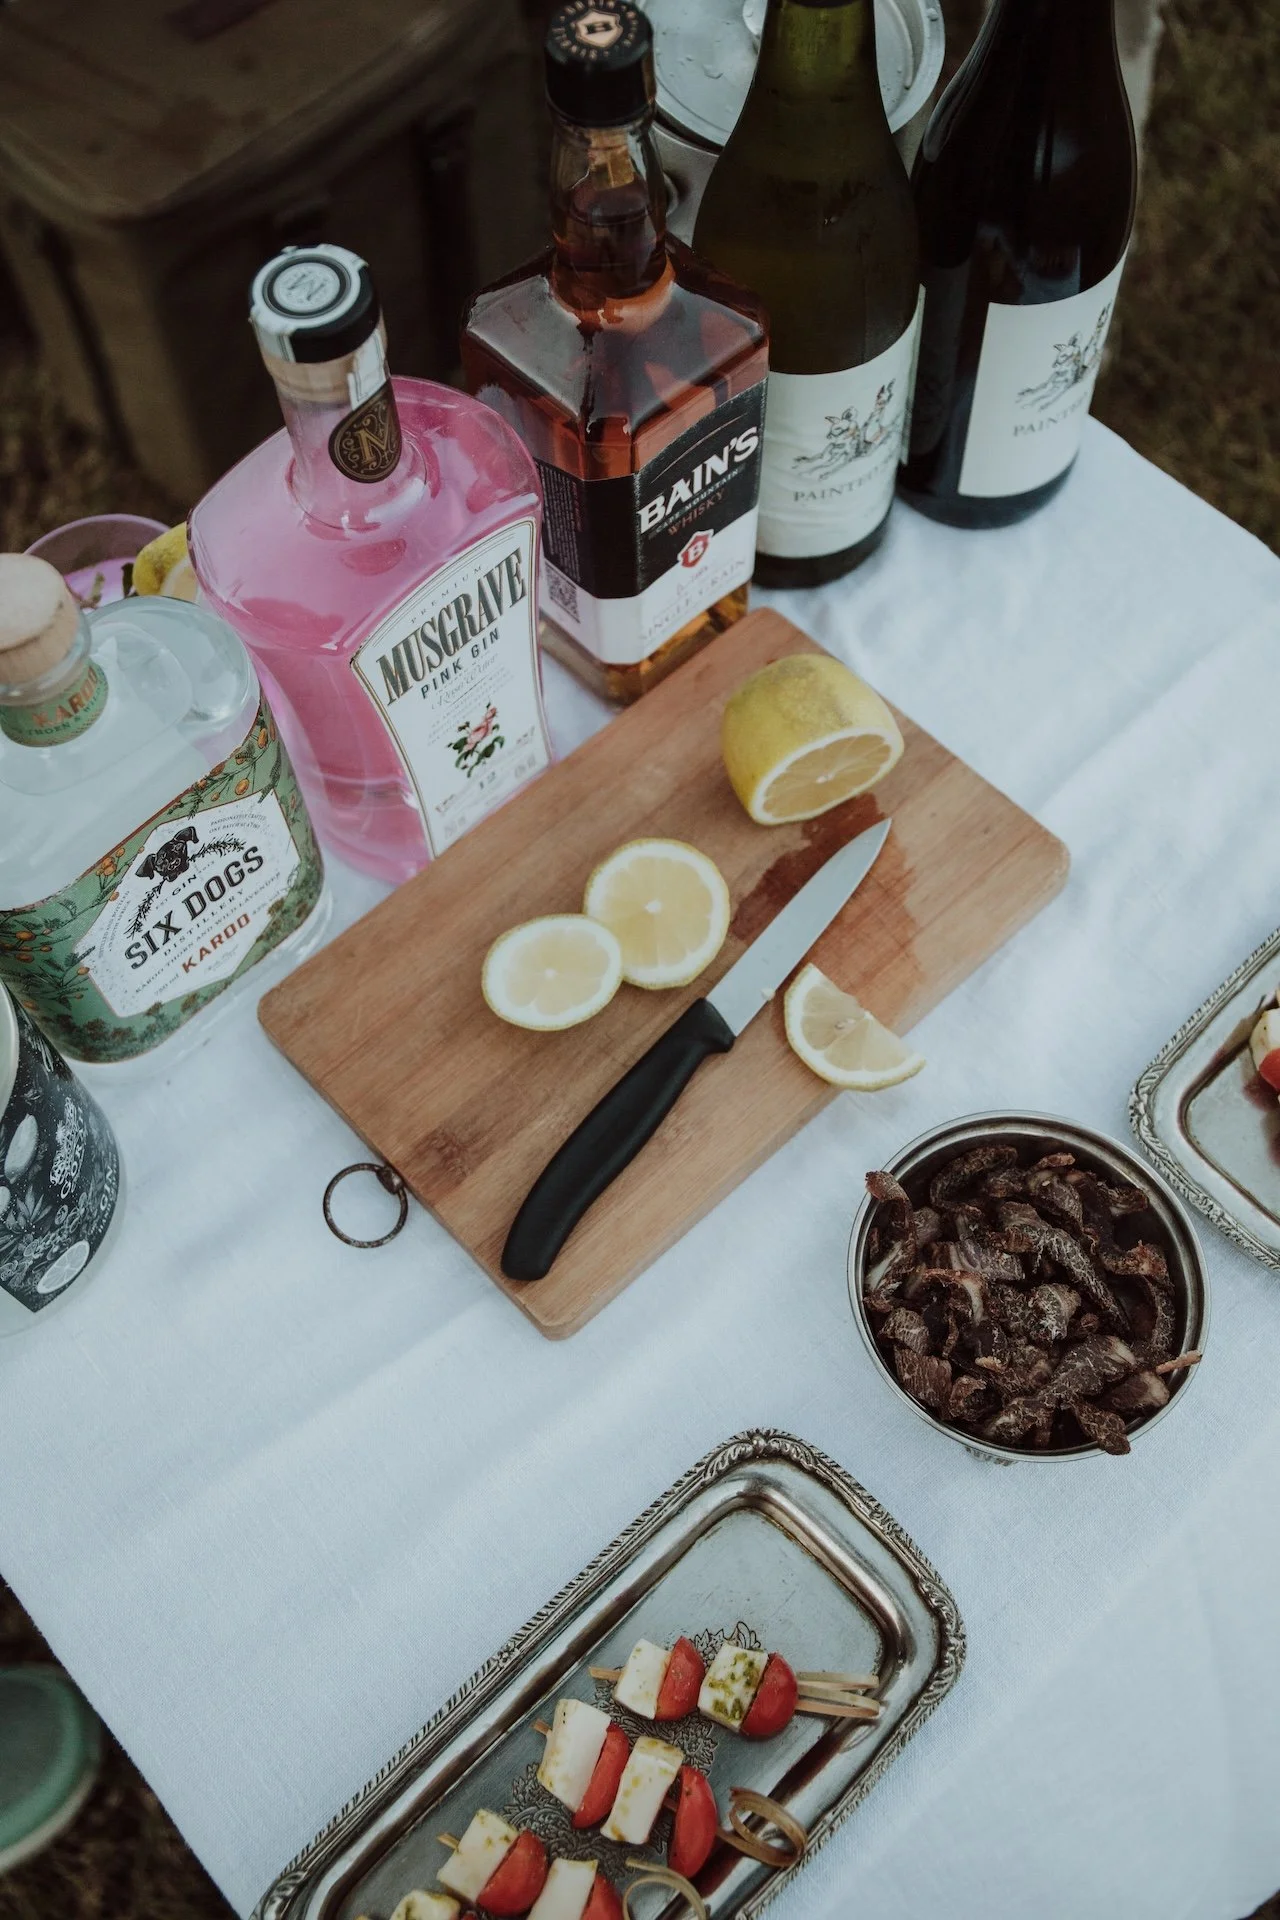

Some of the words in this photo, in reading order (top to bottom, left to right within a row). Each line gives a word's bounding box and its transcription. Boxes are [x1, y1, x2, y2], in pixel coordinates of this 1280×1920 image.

[636, 426, 759, 534] BAIN'S
[685, 469, 739, 510] MOUNTAIN
[668, 487, 725, 536] WHISKY
[688, 540, 704, 562] B
[410, 565, 482, 624] PREMIUM
[375, 547, 528, 706] MUSGRAVE
[420, 657, 463, 699] PINK
[470, 627, 499, 659] GIN
[123, 910, 182, 970] SIX
[182, 845, 264, 921] DOGS
[173, 874, 197, 895] GIN
[163, 888, 245, 957] DISTILLERY
[181, 912, 252, 974] KAROO
[99, 1165, 115, 1212] GIN
